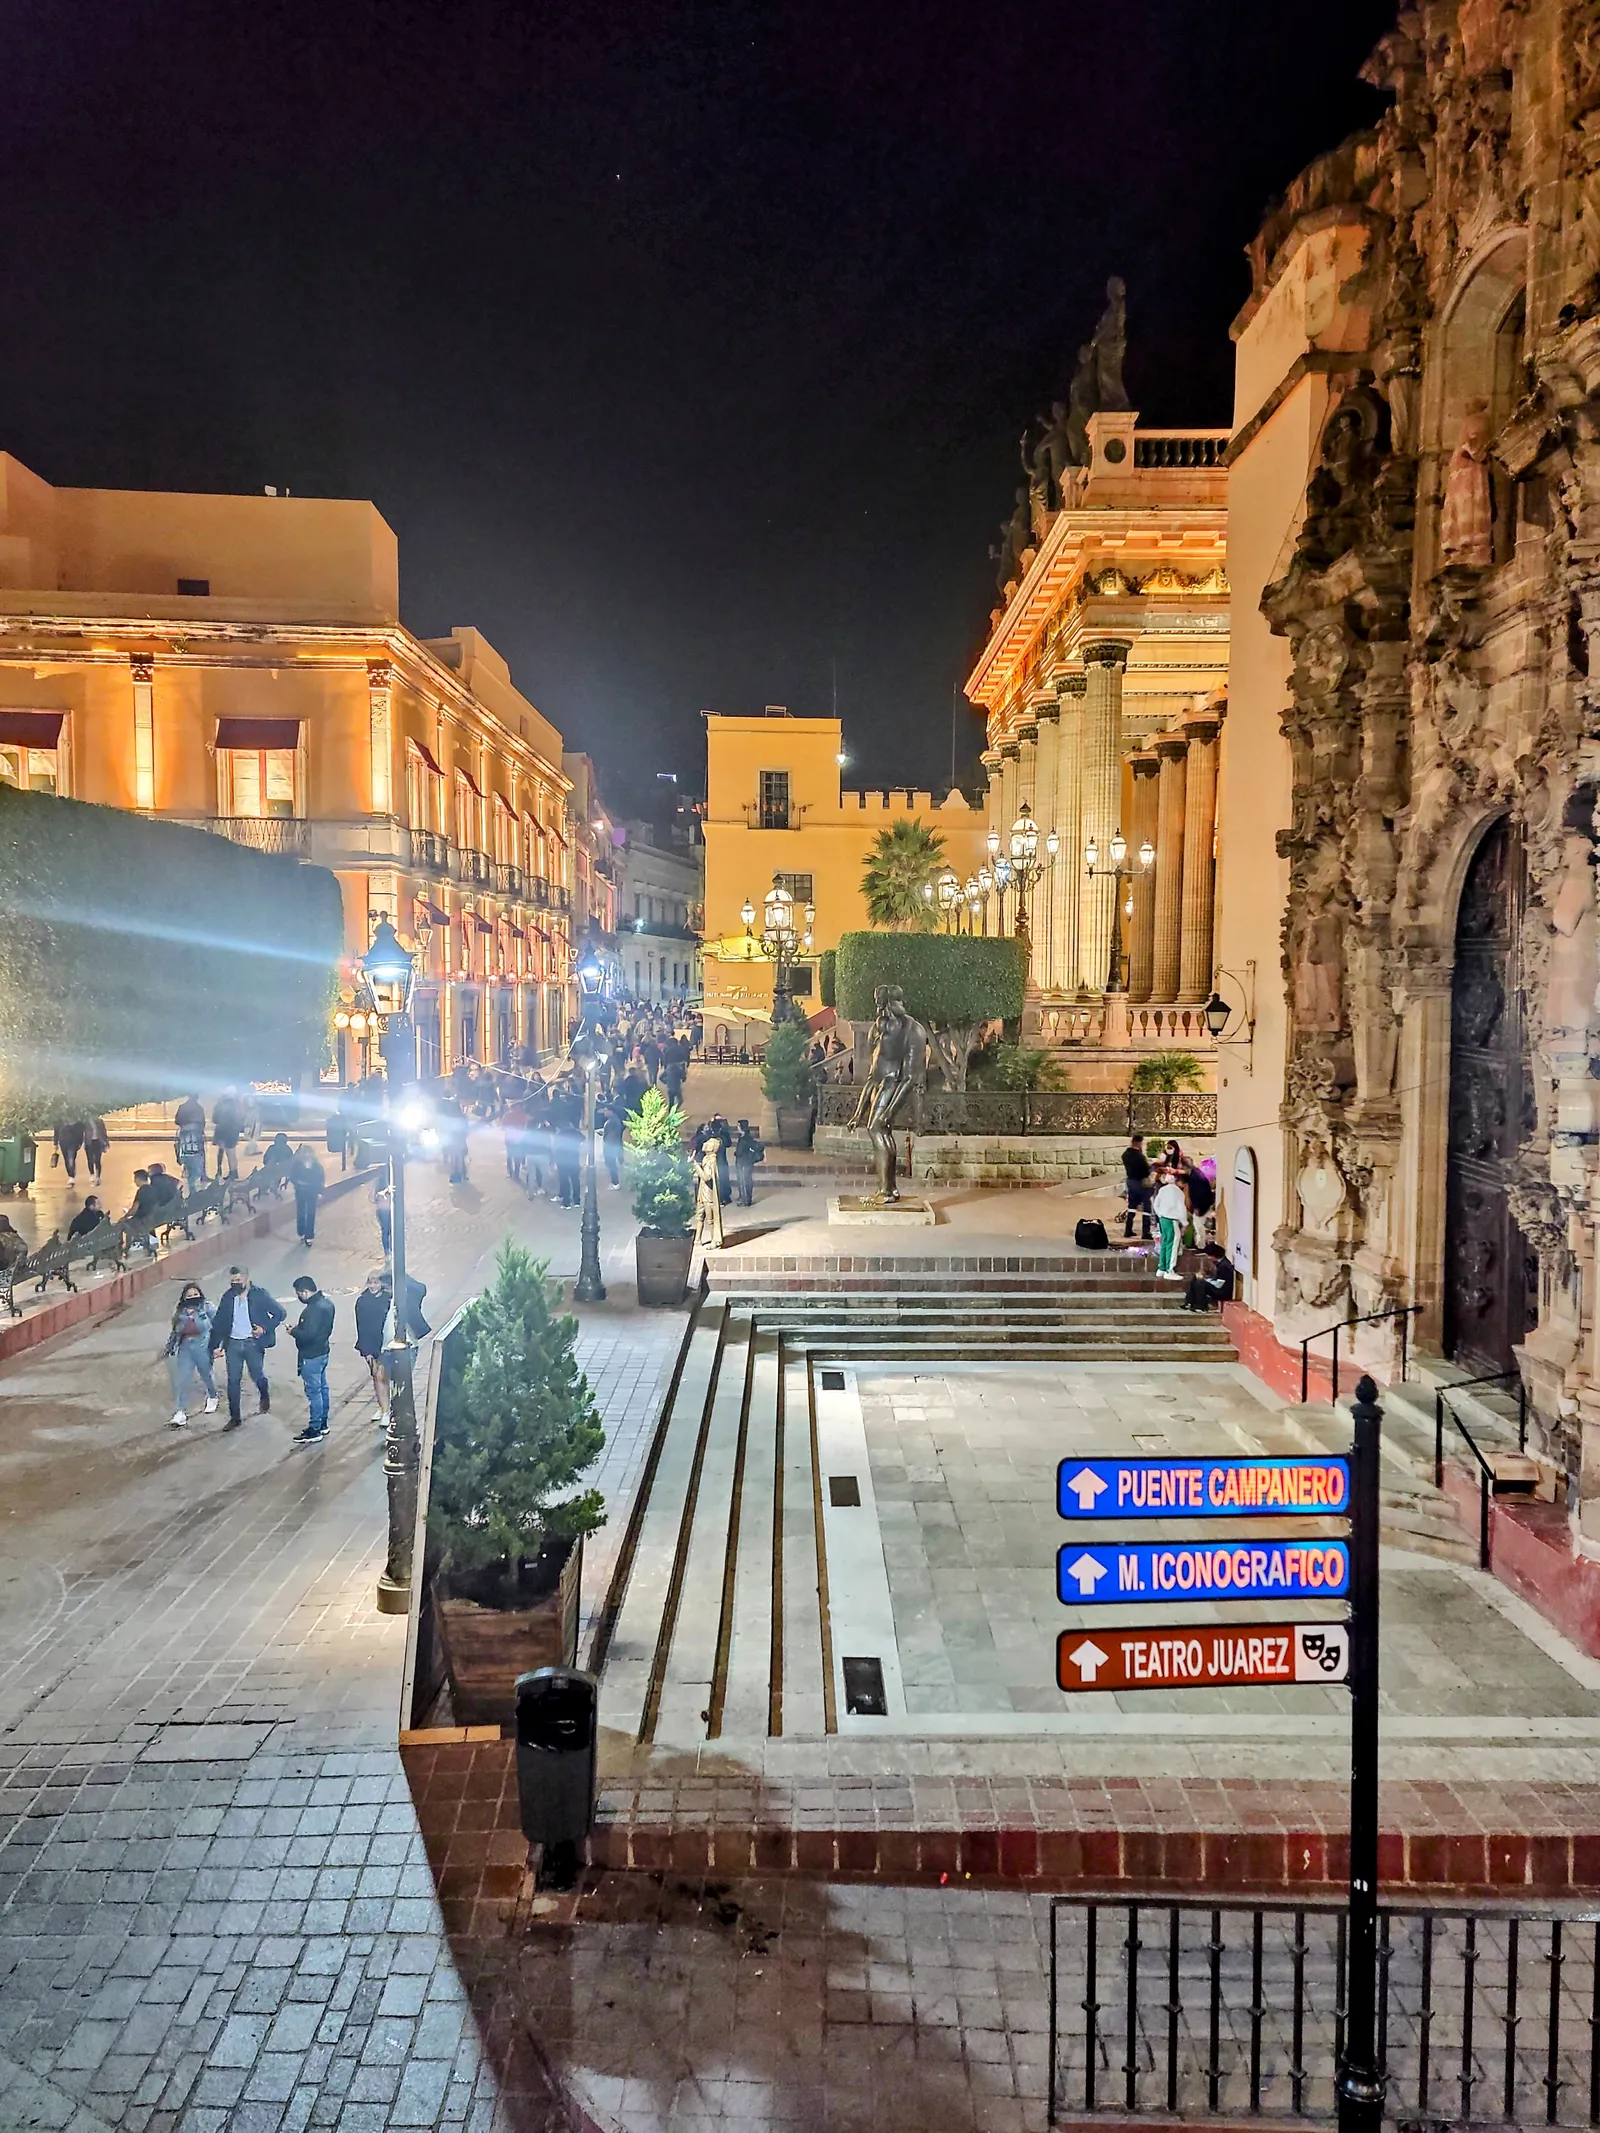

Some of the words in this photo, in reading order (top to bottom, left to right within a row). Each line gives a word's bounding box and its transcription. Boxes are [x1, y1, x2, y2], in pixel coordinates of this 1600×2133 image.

[1118, 1469, 1203, 1507] PUENTE
[1208, 1466, 1345, 1506] CAMPANERO
[1118, 1554, 1145, 1591] M.
[1152, 1548, 1344, 1590] ICONOGRAFICO
[1121, 1639, 1203, 1679] TEATRO
[1207, 1637, 1290, 1677] JUAREZ
